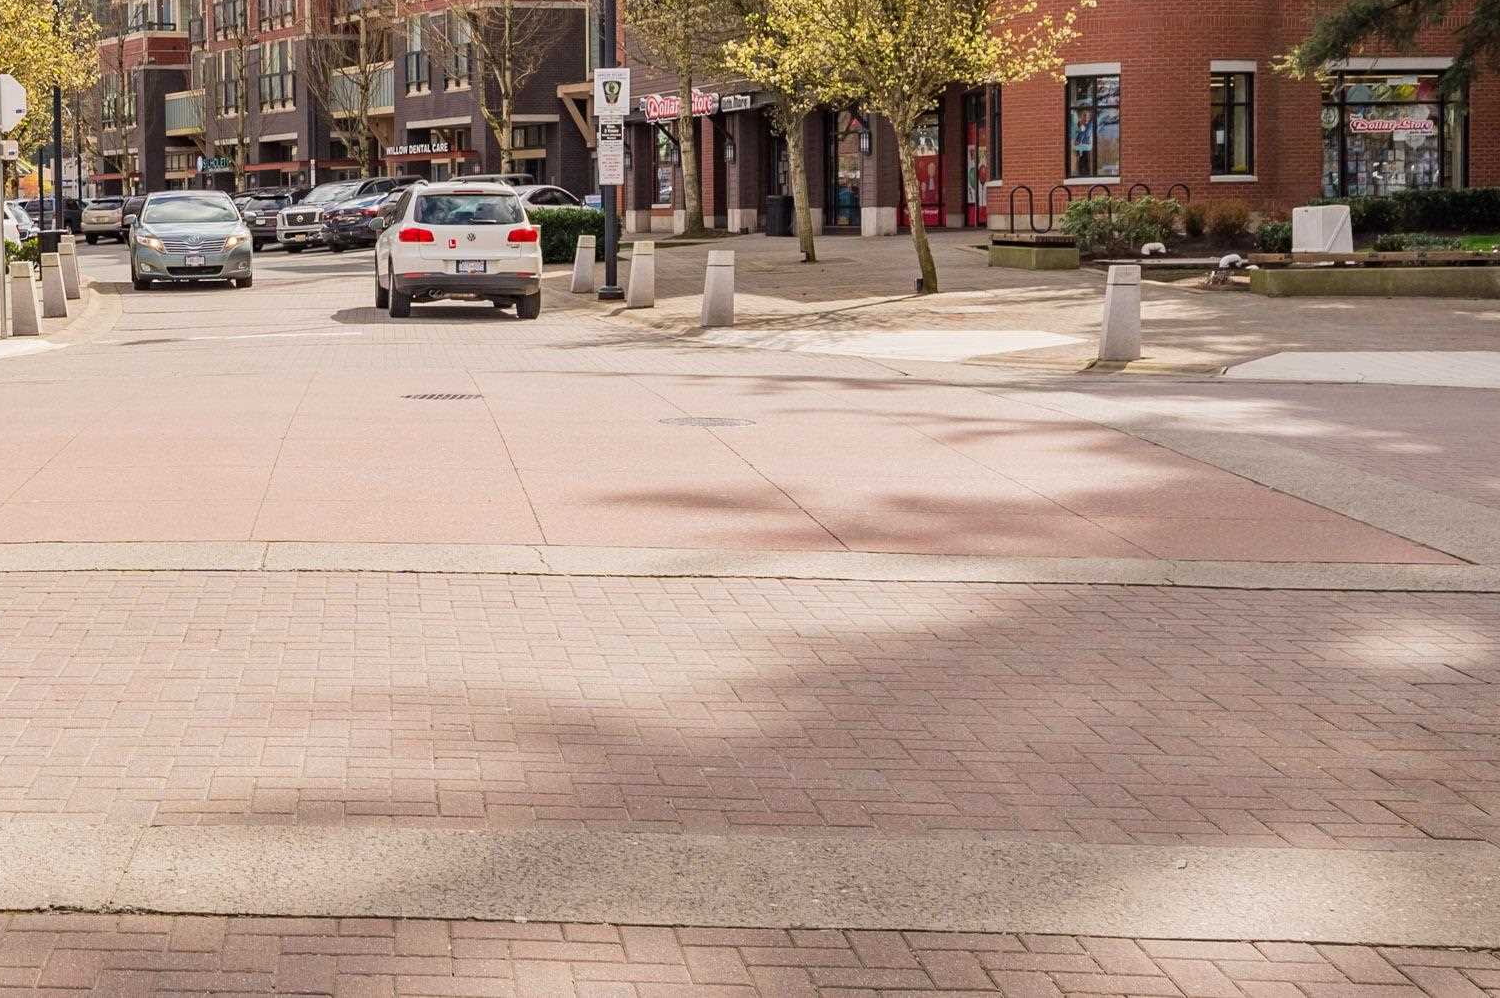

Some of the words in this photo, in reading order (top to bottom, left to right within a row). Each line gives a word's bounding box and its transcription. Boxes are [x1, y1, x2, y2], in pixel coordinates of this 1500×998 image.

[1352, 120, 1396, 131] Dollar
[1396, 119, 1433, 130] Store
[386, 146, 408, 155] WILLOW
[409, 144, 431, 154] DENTAL
[432, 142, 449, 152] CARE
